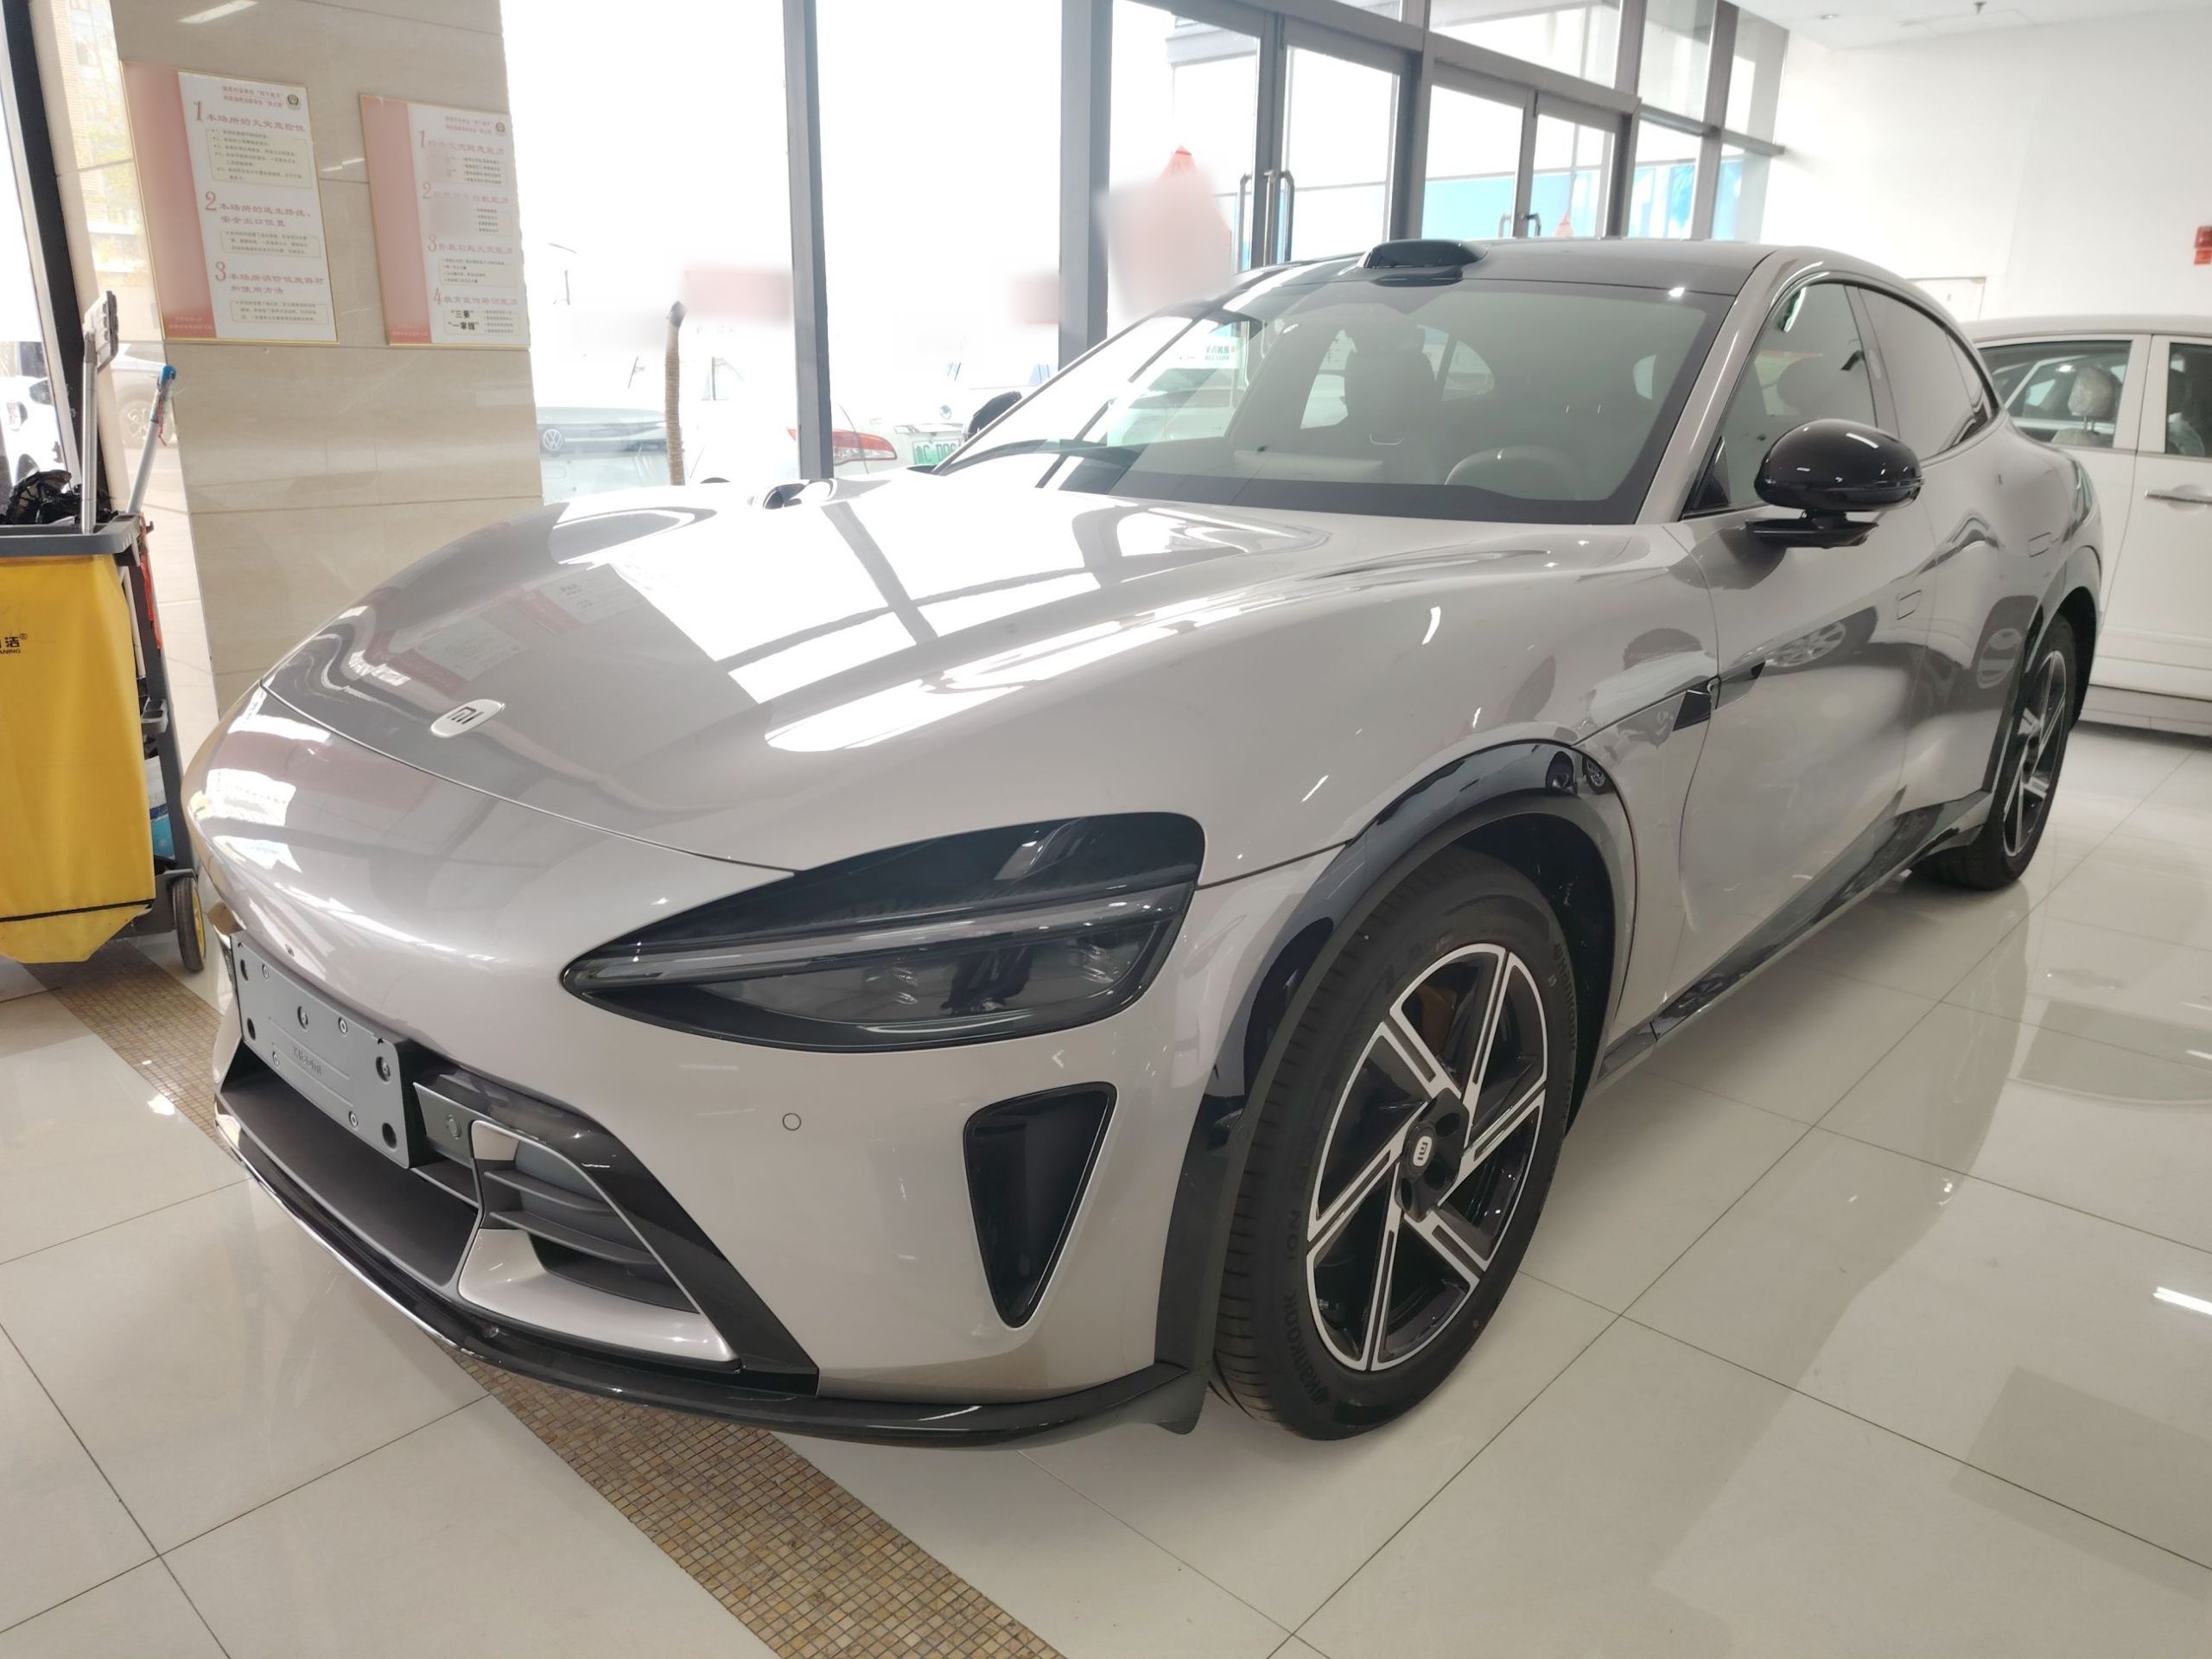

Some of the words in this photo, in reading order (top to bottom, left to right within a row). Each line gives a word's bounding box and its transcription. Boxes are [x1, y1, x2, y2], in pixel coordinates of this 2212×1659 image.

[194, 100, 203, 122] 1
[418, 130, 426, 149] 1
[423, 181, 432, 200] 2
[205, 191, 217, 212] 2
[428, 234, 437, 252] 3
[215, 261, 226, 282] 3
[434, 288, 442, 306] 4
